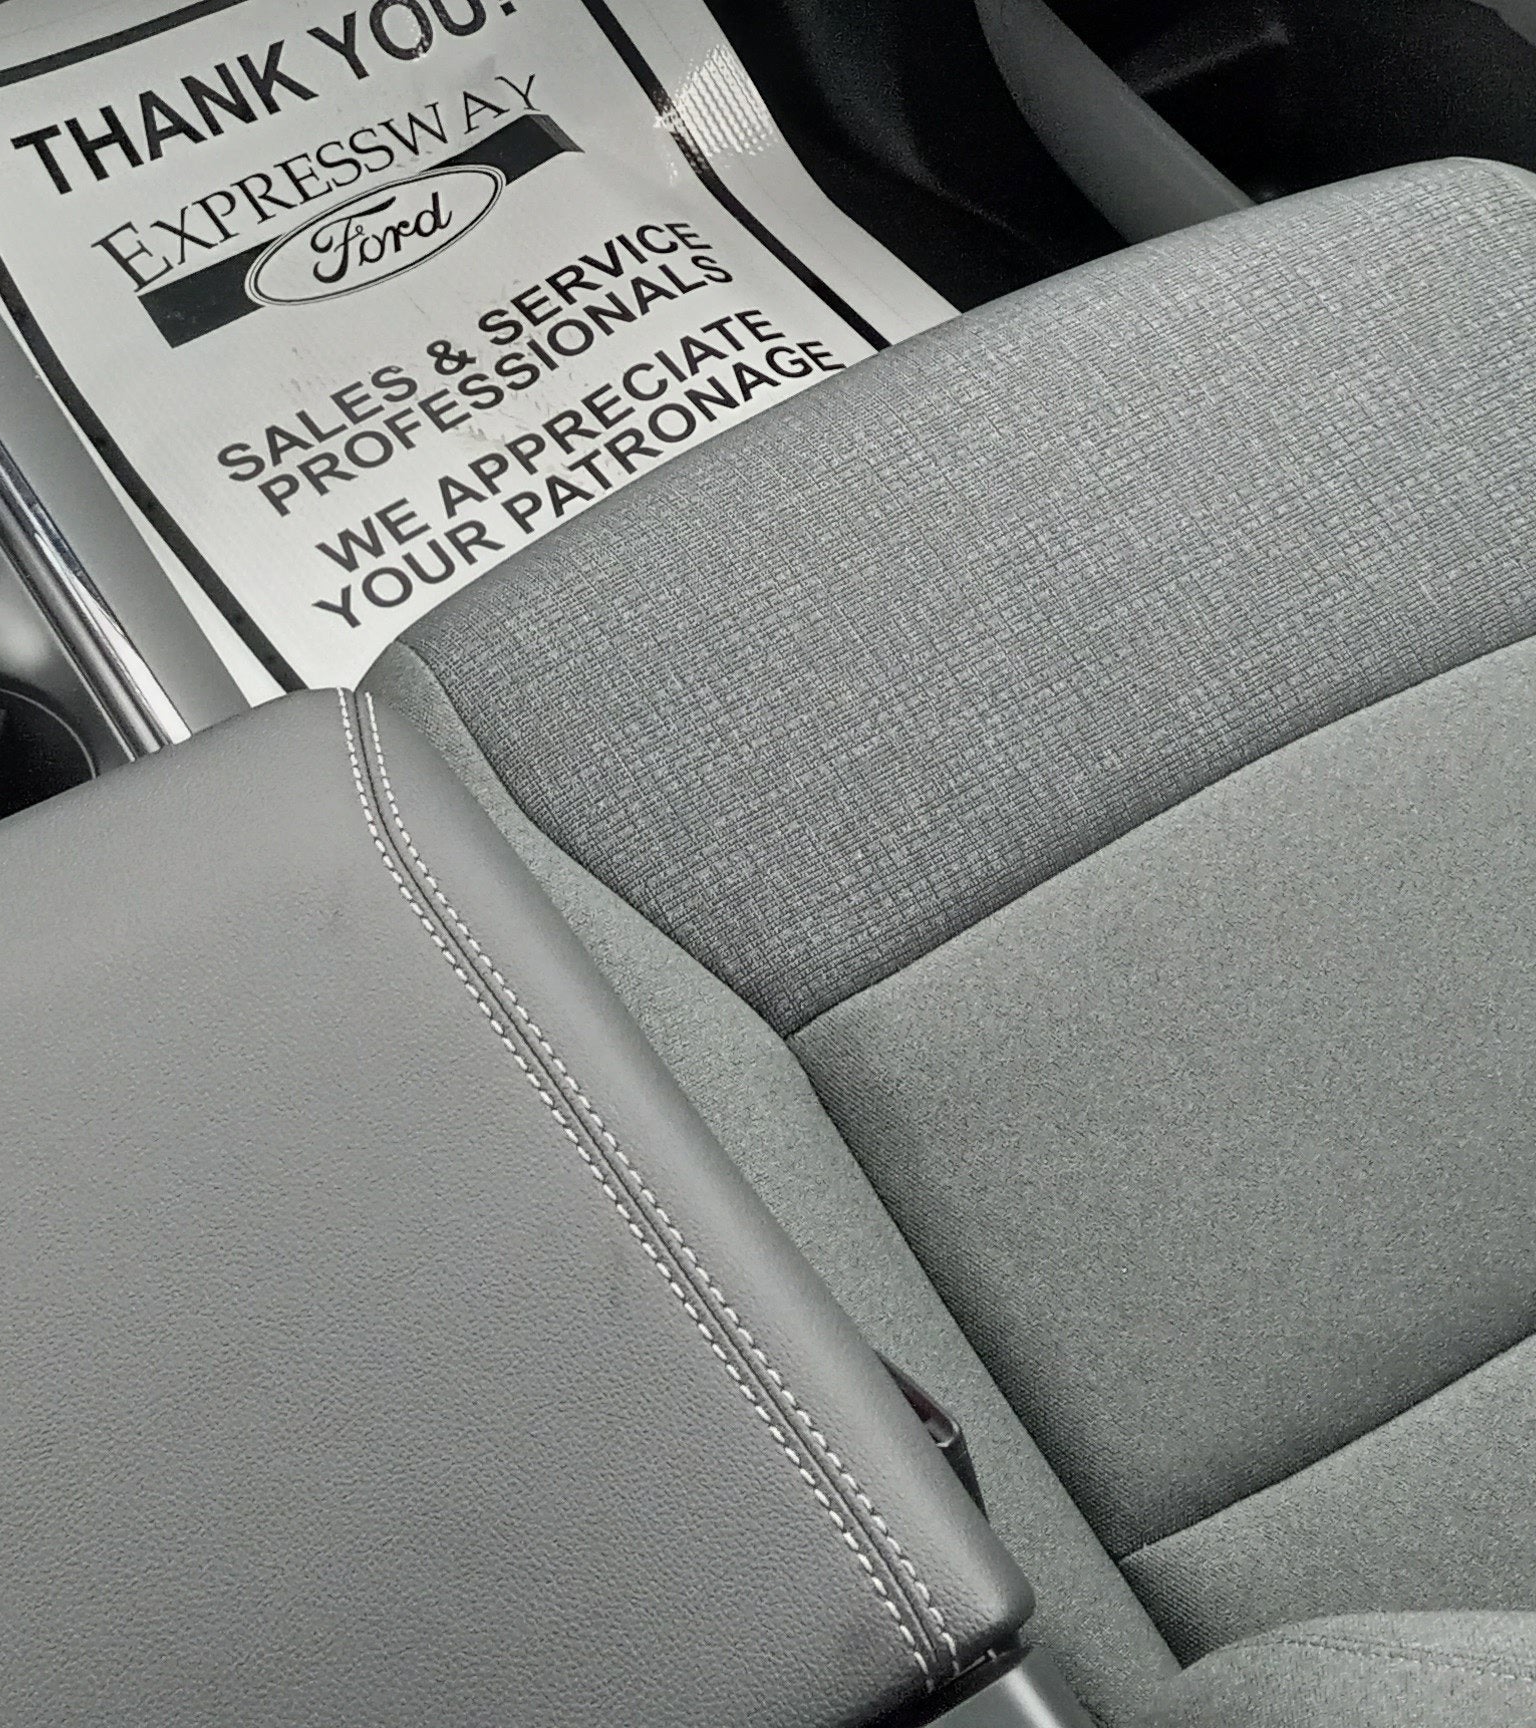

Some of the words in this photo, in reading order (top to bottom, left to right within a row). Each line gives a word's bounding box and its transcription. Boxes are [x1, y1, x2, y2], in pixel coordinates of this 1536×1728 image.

[10, 40, 319, 198] THANK
[90, 70, 542, 296] EXPRESSWAY
[310, 186, 456, 287] Ford
[216, 362, 421, 486] SALES
[425, 333, 479, 375] &
[476, 219, 716, 349] SERVICE
[255, 252, 738, 520] PROFESSIONALS
[309, 521, 507, 632] YOUR
[497, 336, 849, 538] PATRONAGE
[313, 496, 434, 574] WE
[436, 306, 789, 520] APPRECIATE
